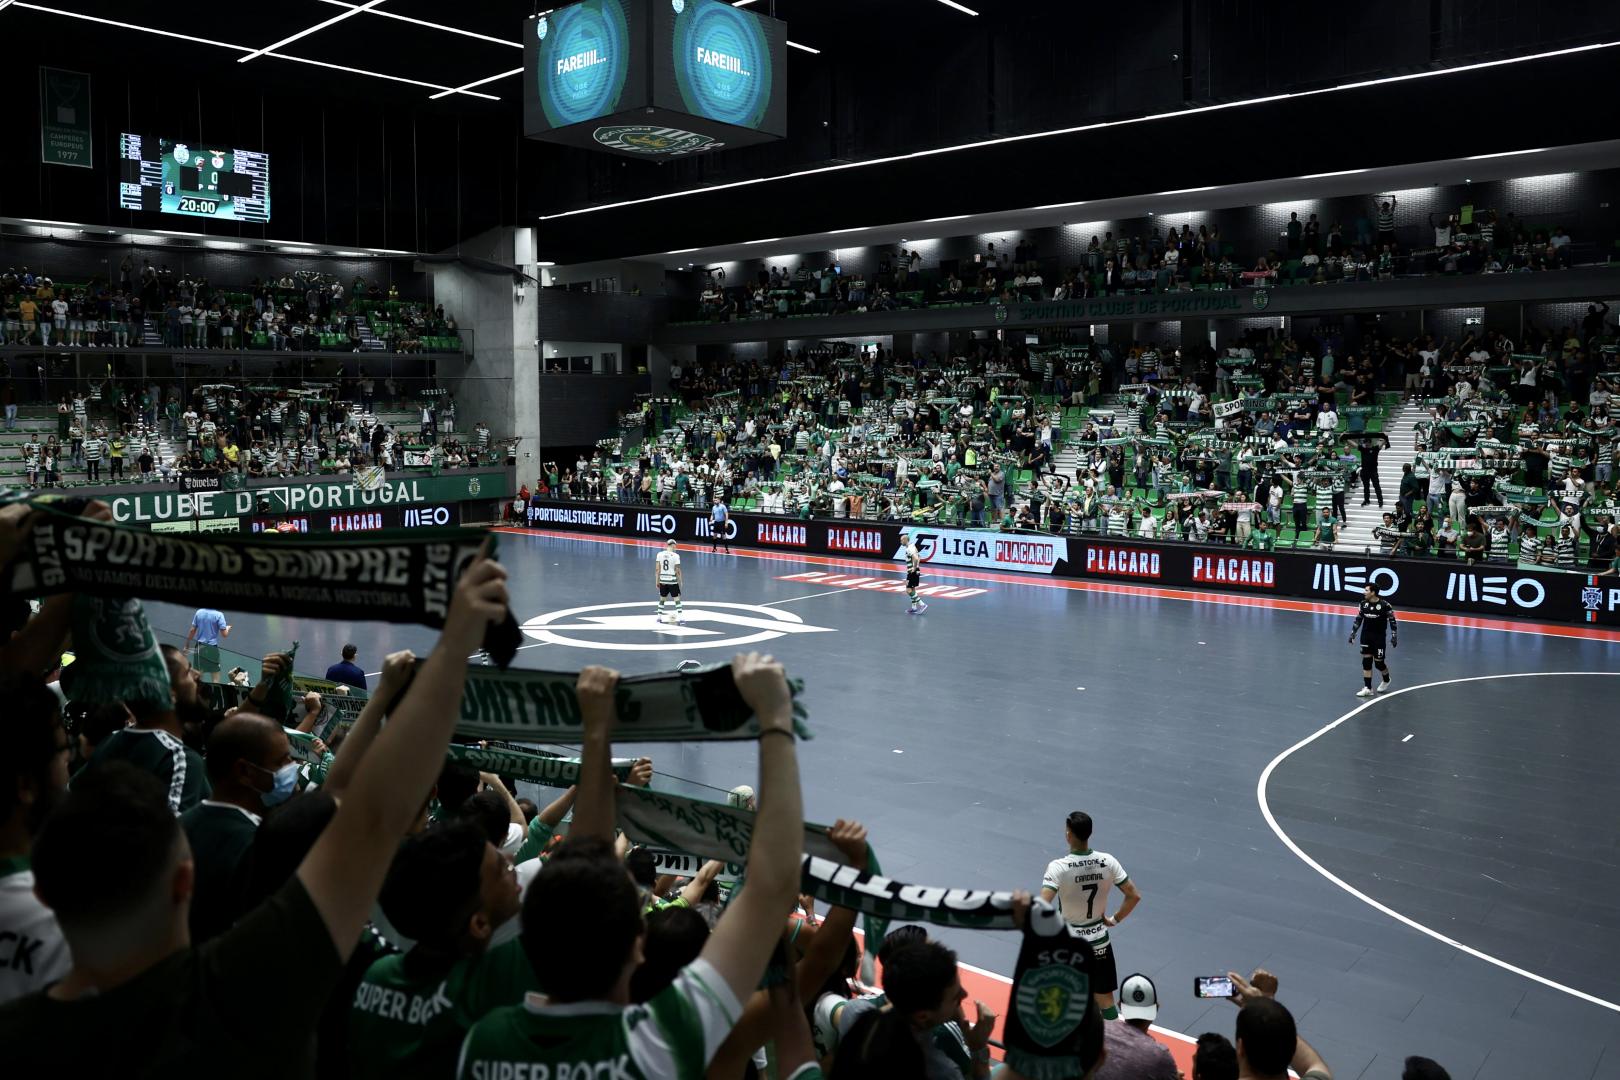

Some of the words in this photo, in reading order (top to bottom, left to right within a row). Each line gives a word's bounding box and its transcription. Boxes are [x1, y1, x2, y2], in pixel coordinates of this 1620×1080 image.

[57, 150, 78, 160] 1977
[181, 199, 215, 213] 20:00
[1019, 302, 1085, 321] SPORTING
[1088, 299, 1133, 317] CLUBE
[1136, 298, 1157, 315] DE
[1161, 294, 1242, 314] PORTUGAL
[1225, 399, 1265, 412] SPORTING
[112, 493, 215, 522] CLUBE
[291, 480, 425, 510] PORTUGAL
[331, 513, 383, 532] PLACARD
[405, 506, 450, 528] MEO
[534, 508, 625, 528] PORTUGALSTORE.FPF.PT
[637, 513, 676, 534] MEO
[696, 516, 737, 540] MO
[758, 523, 806, 544] PLACARD
[828, 528, 882, 551] PLACARD
[63, 525, 244, 576] SPORTING
[244, 545, 412, 586] SEMPRE
[943, 537, 989, 559] LIGA
[996, 541, 1053, 565] PLACARD
[1087, 548, 1160, 576] PLACARD
[663, 559, 669, 571] 8
[1193, 555, 1274, 586] PLACARD
[94, 568, 143, 588] VAMOS
[145, 574, 198, 592] DEIXAR
[200, 578, 265, 598] MORRER
[280, 584, 333, 604] NOSSA
[1312, 563, 1398, 597] MEO
[1445, 572, 1544, 608] MEO
[1068, 858, 1101, 869] FILSTONE
[1075, 873, 1104, 884] CARDINAL
[1082, 884, 1098, 919] 7
[1037, 948, 1085, 966] SCP
[353, 980, 405, 1022] SUPER
[472, 1059, 551, 1080] SUPER
